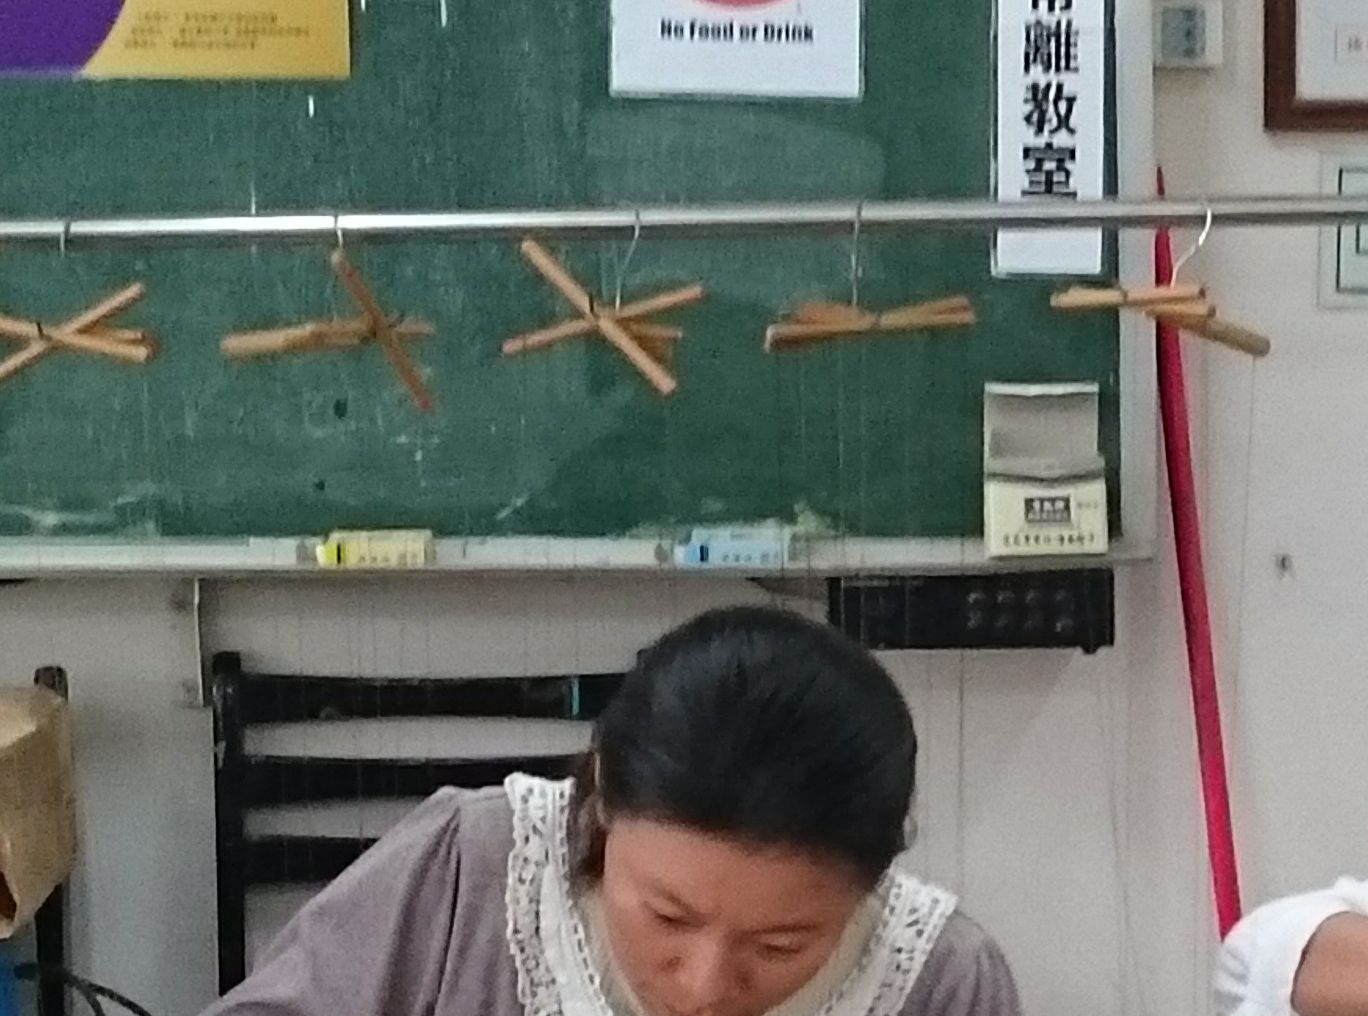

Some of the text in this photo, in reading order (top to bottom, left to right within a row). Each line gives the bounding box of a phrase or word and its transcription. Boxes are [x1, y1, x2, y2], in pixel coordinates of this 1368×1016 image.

[660, 18, 813, 44] No Food or Drink
[1021, 0, 1079, 199] 離教室
